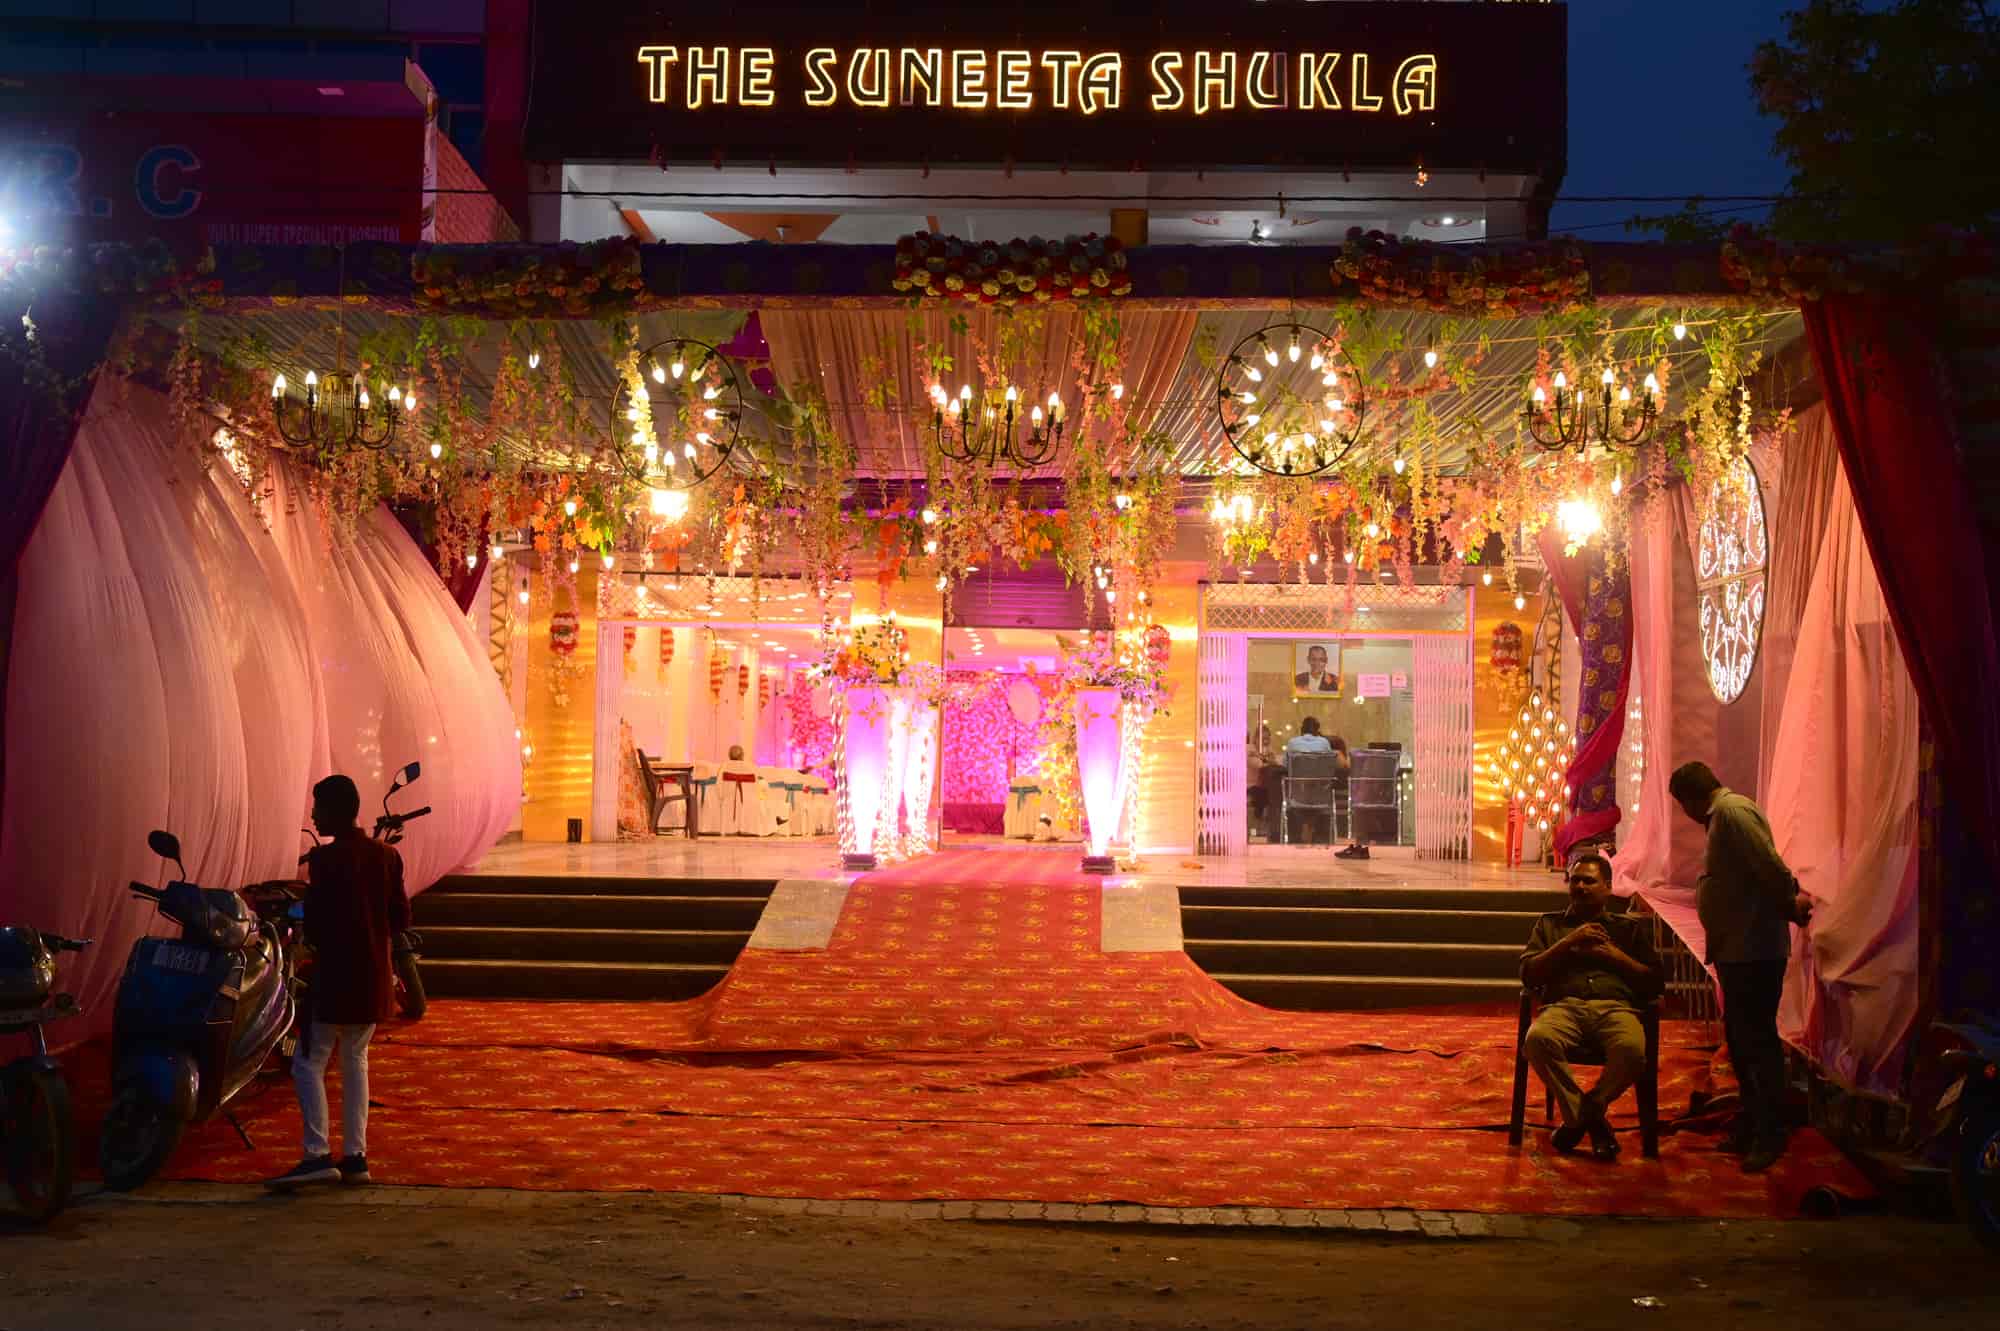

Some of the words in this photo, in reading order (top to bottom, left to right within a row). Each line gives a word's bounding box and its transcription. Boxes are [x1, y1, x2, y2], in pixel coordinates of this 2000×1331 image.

[635, 43, 775, 109] THE
[803, 46, 1122, 115] SUNEETA
[1149, 49, 1439, 115] SHUKLA
